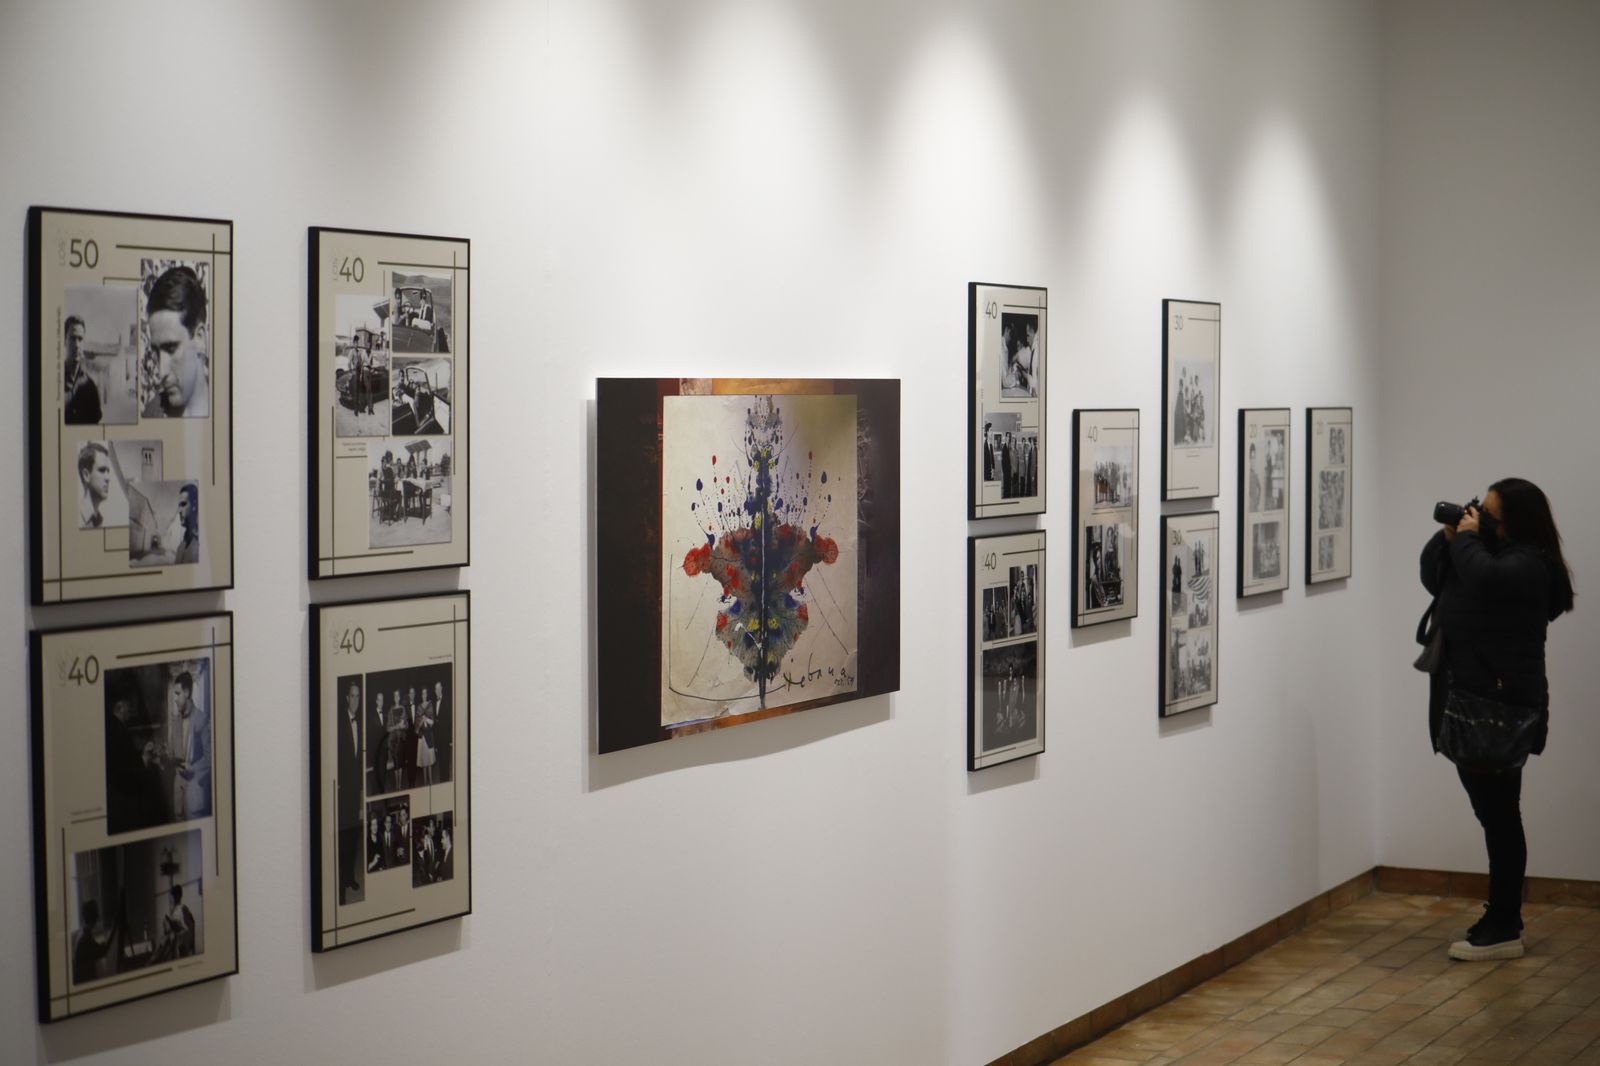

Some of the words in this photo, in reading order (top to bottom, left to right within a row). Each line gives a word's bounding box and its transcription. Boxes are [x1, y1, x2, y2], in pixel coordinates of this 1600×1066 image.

[69, 238, 99, 269] 50
[339, 256, 365, 283] 40
[985, 300, 997, 320] 40
[1087, 425, 1098, 443] 40
[984, 551, 997, 572] 40
[339, 627, 365, 654] 40
[68, 654, 100, 687] 40
